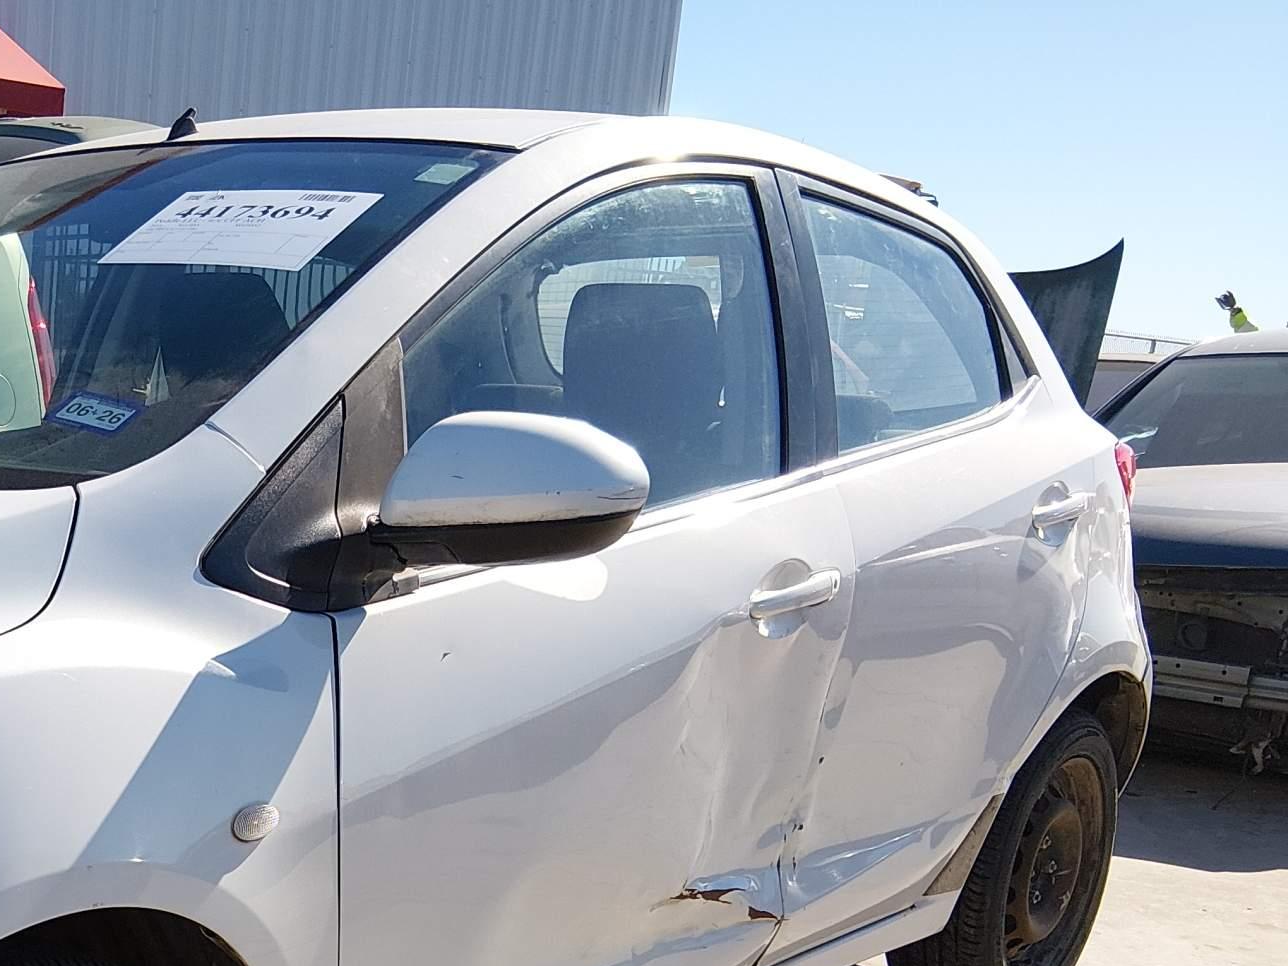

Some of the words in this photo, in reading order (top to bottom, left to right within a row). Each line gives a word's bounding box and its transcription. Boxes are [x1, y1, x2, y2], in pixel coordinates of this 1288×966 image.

[175, 205, 337, 221] 44173694
[65, 402, 94, 417] 06
[95, 409, 126, 425] 26
